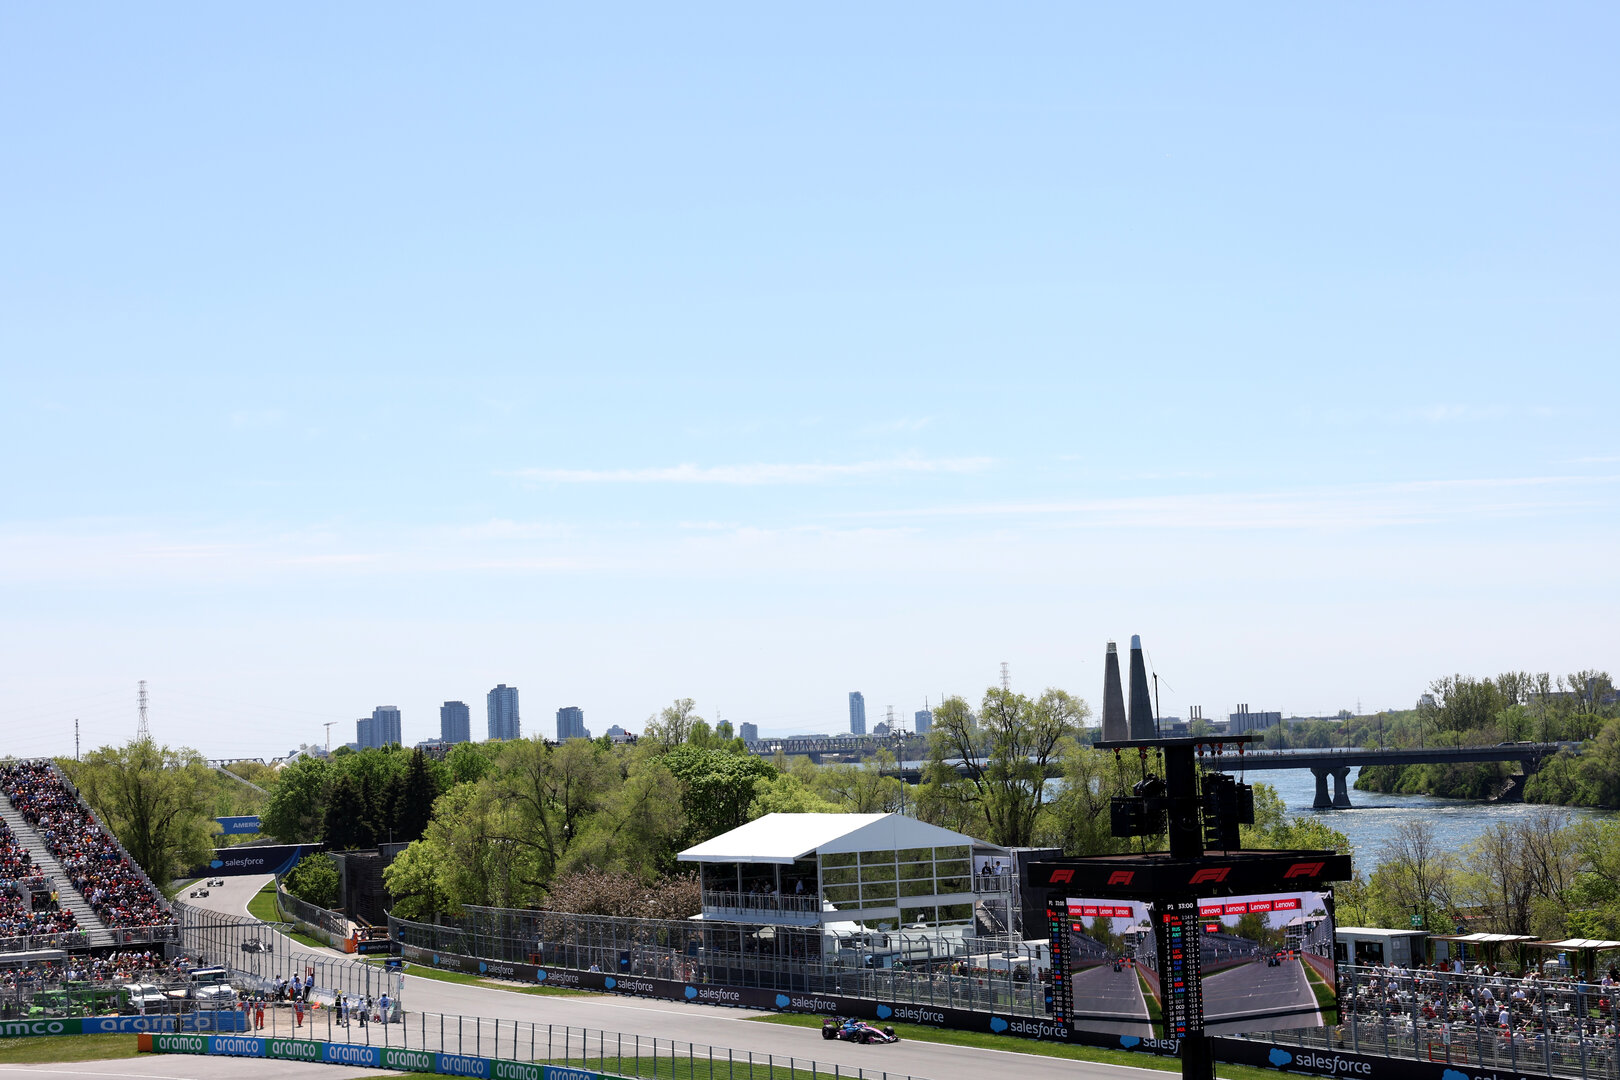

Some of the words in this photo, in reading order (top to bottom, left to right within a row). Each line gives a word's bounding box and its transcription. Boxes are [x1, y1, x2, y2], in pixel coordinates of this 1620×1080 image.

[224, 857, 264, 868] salesforce
[439, 956, 460, 967] salesforce
[488, 964, 514, 976] salesforce
[547, 971, 579, 984] salesforce
[617, 979, 653, 992] salesforce
[699, 988, 740, 1002] salesforce
[792, 997, 837, 1012] salesforce
[894, 1007, 944, 1022] salesforce
[1010, 1020, 1068, 1038] salesforce
[159, 1037, 202, 1050] aramco
[215, 1038, 258, 1054] aramco
[272, 1042, 316, 1057] aramco
[329, 1046, 373, 1063] aramco
[387, 1051, 429, 1068] aramco
[442, 1056, 484, 1074] aramco
[1296, 1052, 1371, 1074] salesforce
[496, 1062, 538, 1080] aramco
